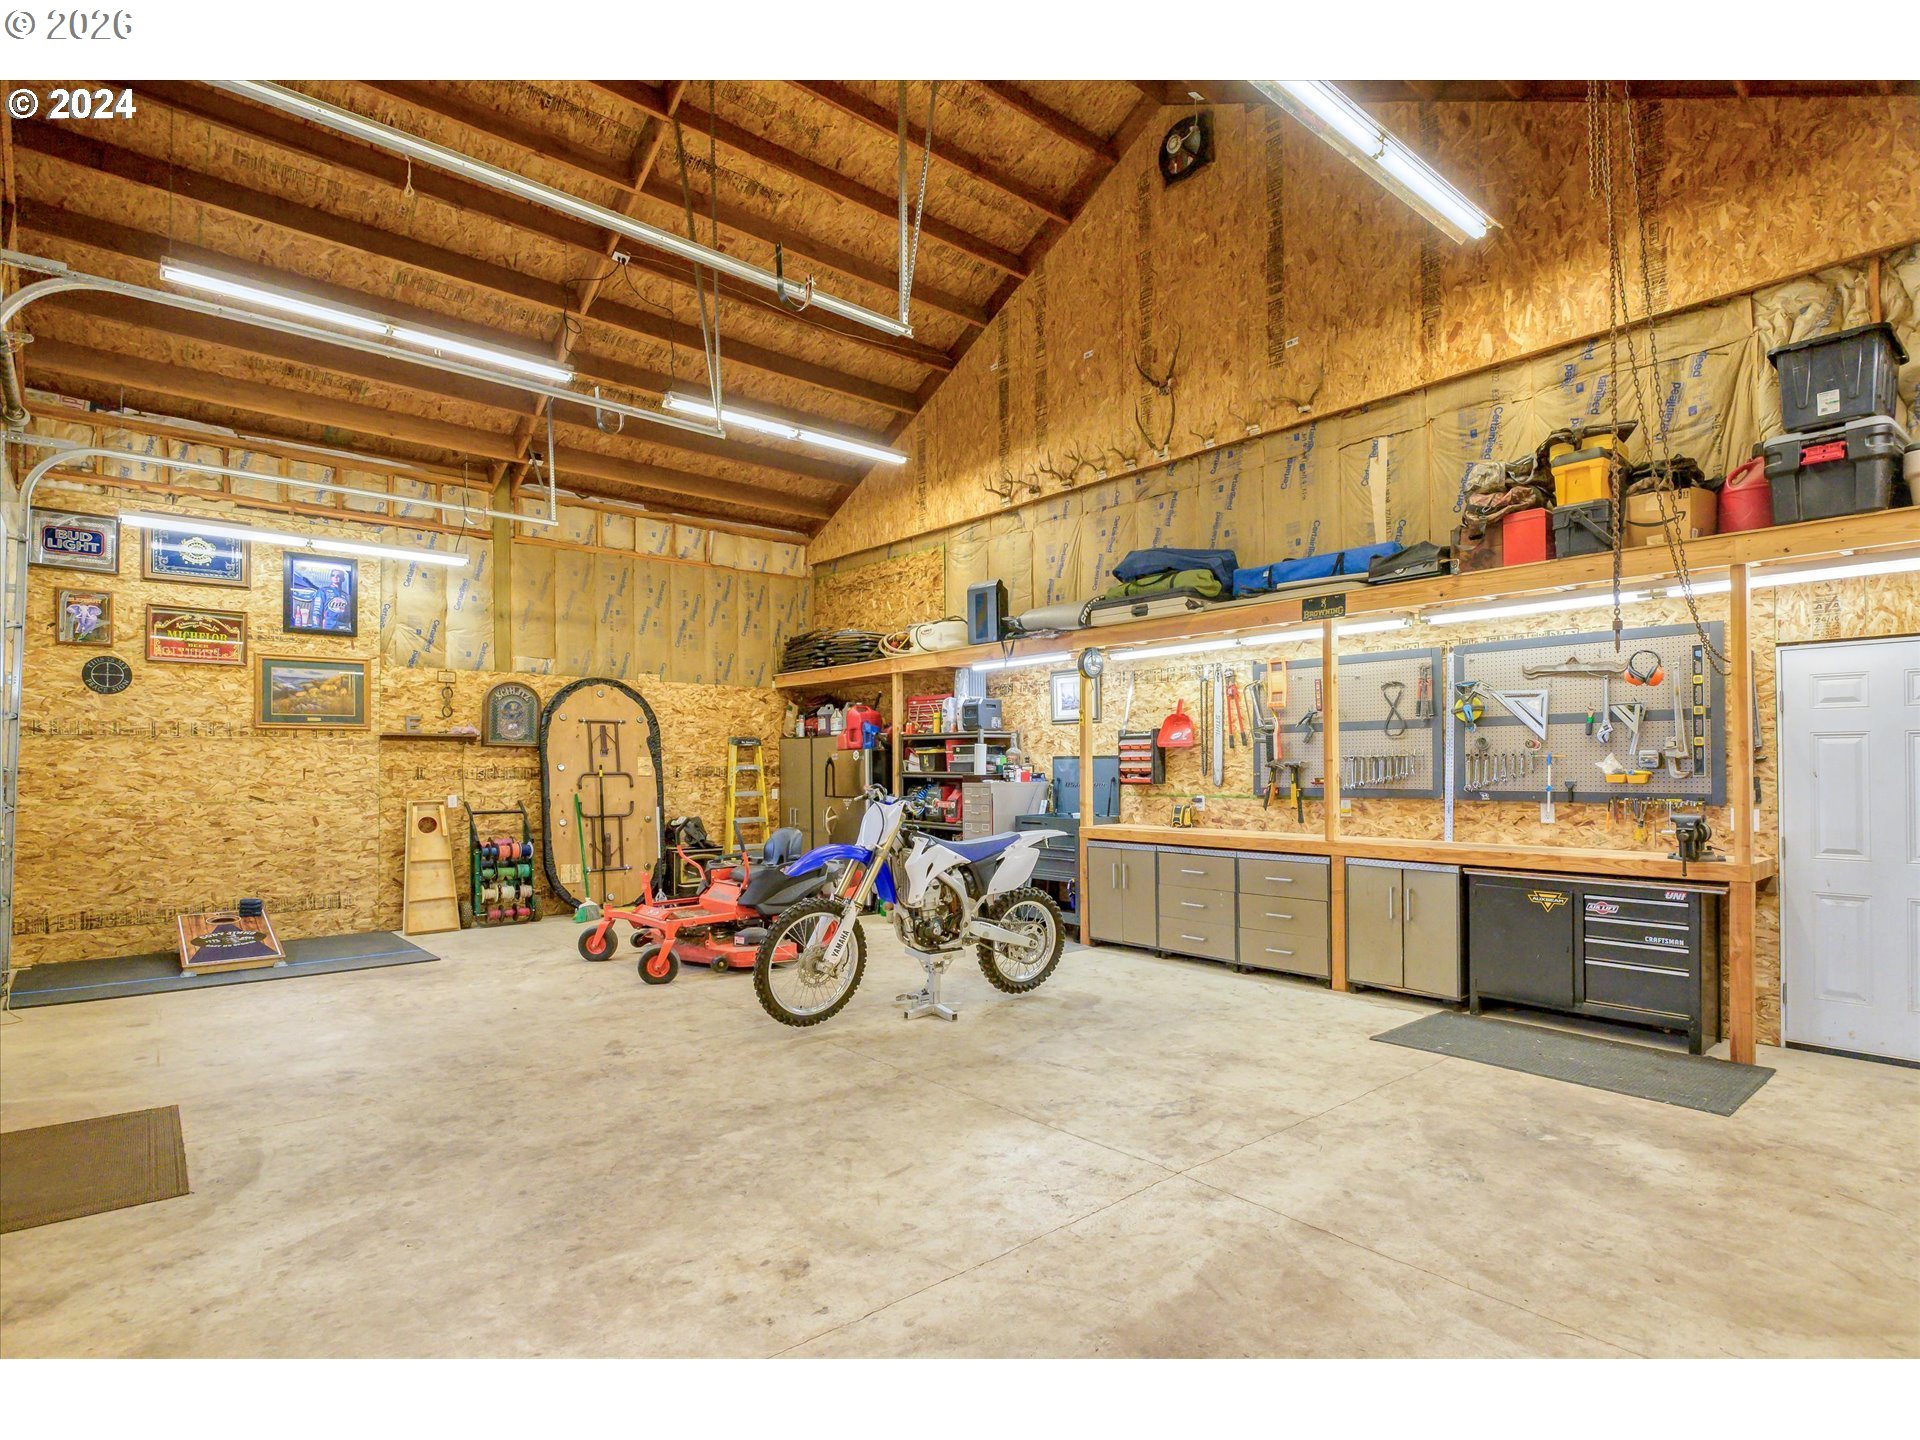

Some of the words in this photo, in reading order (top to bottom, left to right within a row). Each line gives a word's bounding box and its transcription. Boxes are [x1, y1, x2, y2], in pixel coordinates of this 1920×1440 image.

[1484, 407, 1504, 460] CertainTeed
[54, 528, 93, 542] BUD
[47, 537, 100, 553] LIGHT
[1303, 606, 1344, 619] BROWNING
[85, 678, 108, 693] PEACE
[112, 679, 130, 692] SIGN
[1532, 896, 1565, 904] AUXBEAM
[1664, 891, 1687, 901] UNI
[1588, 903, 1601, 911] AIR
[1602, 904, 1618, 912] LIFT
[831, 930, 850, 957] YAMAHA
[1644, 935, 1685, 946] CRAFTSMAN
